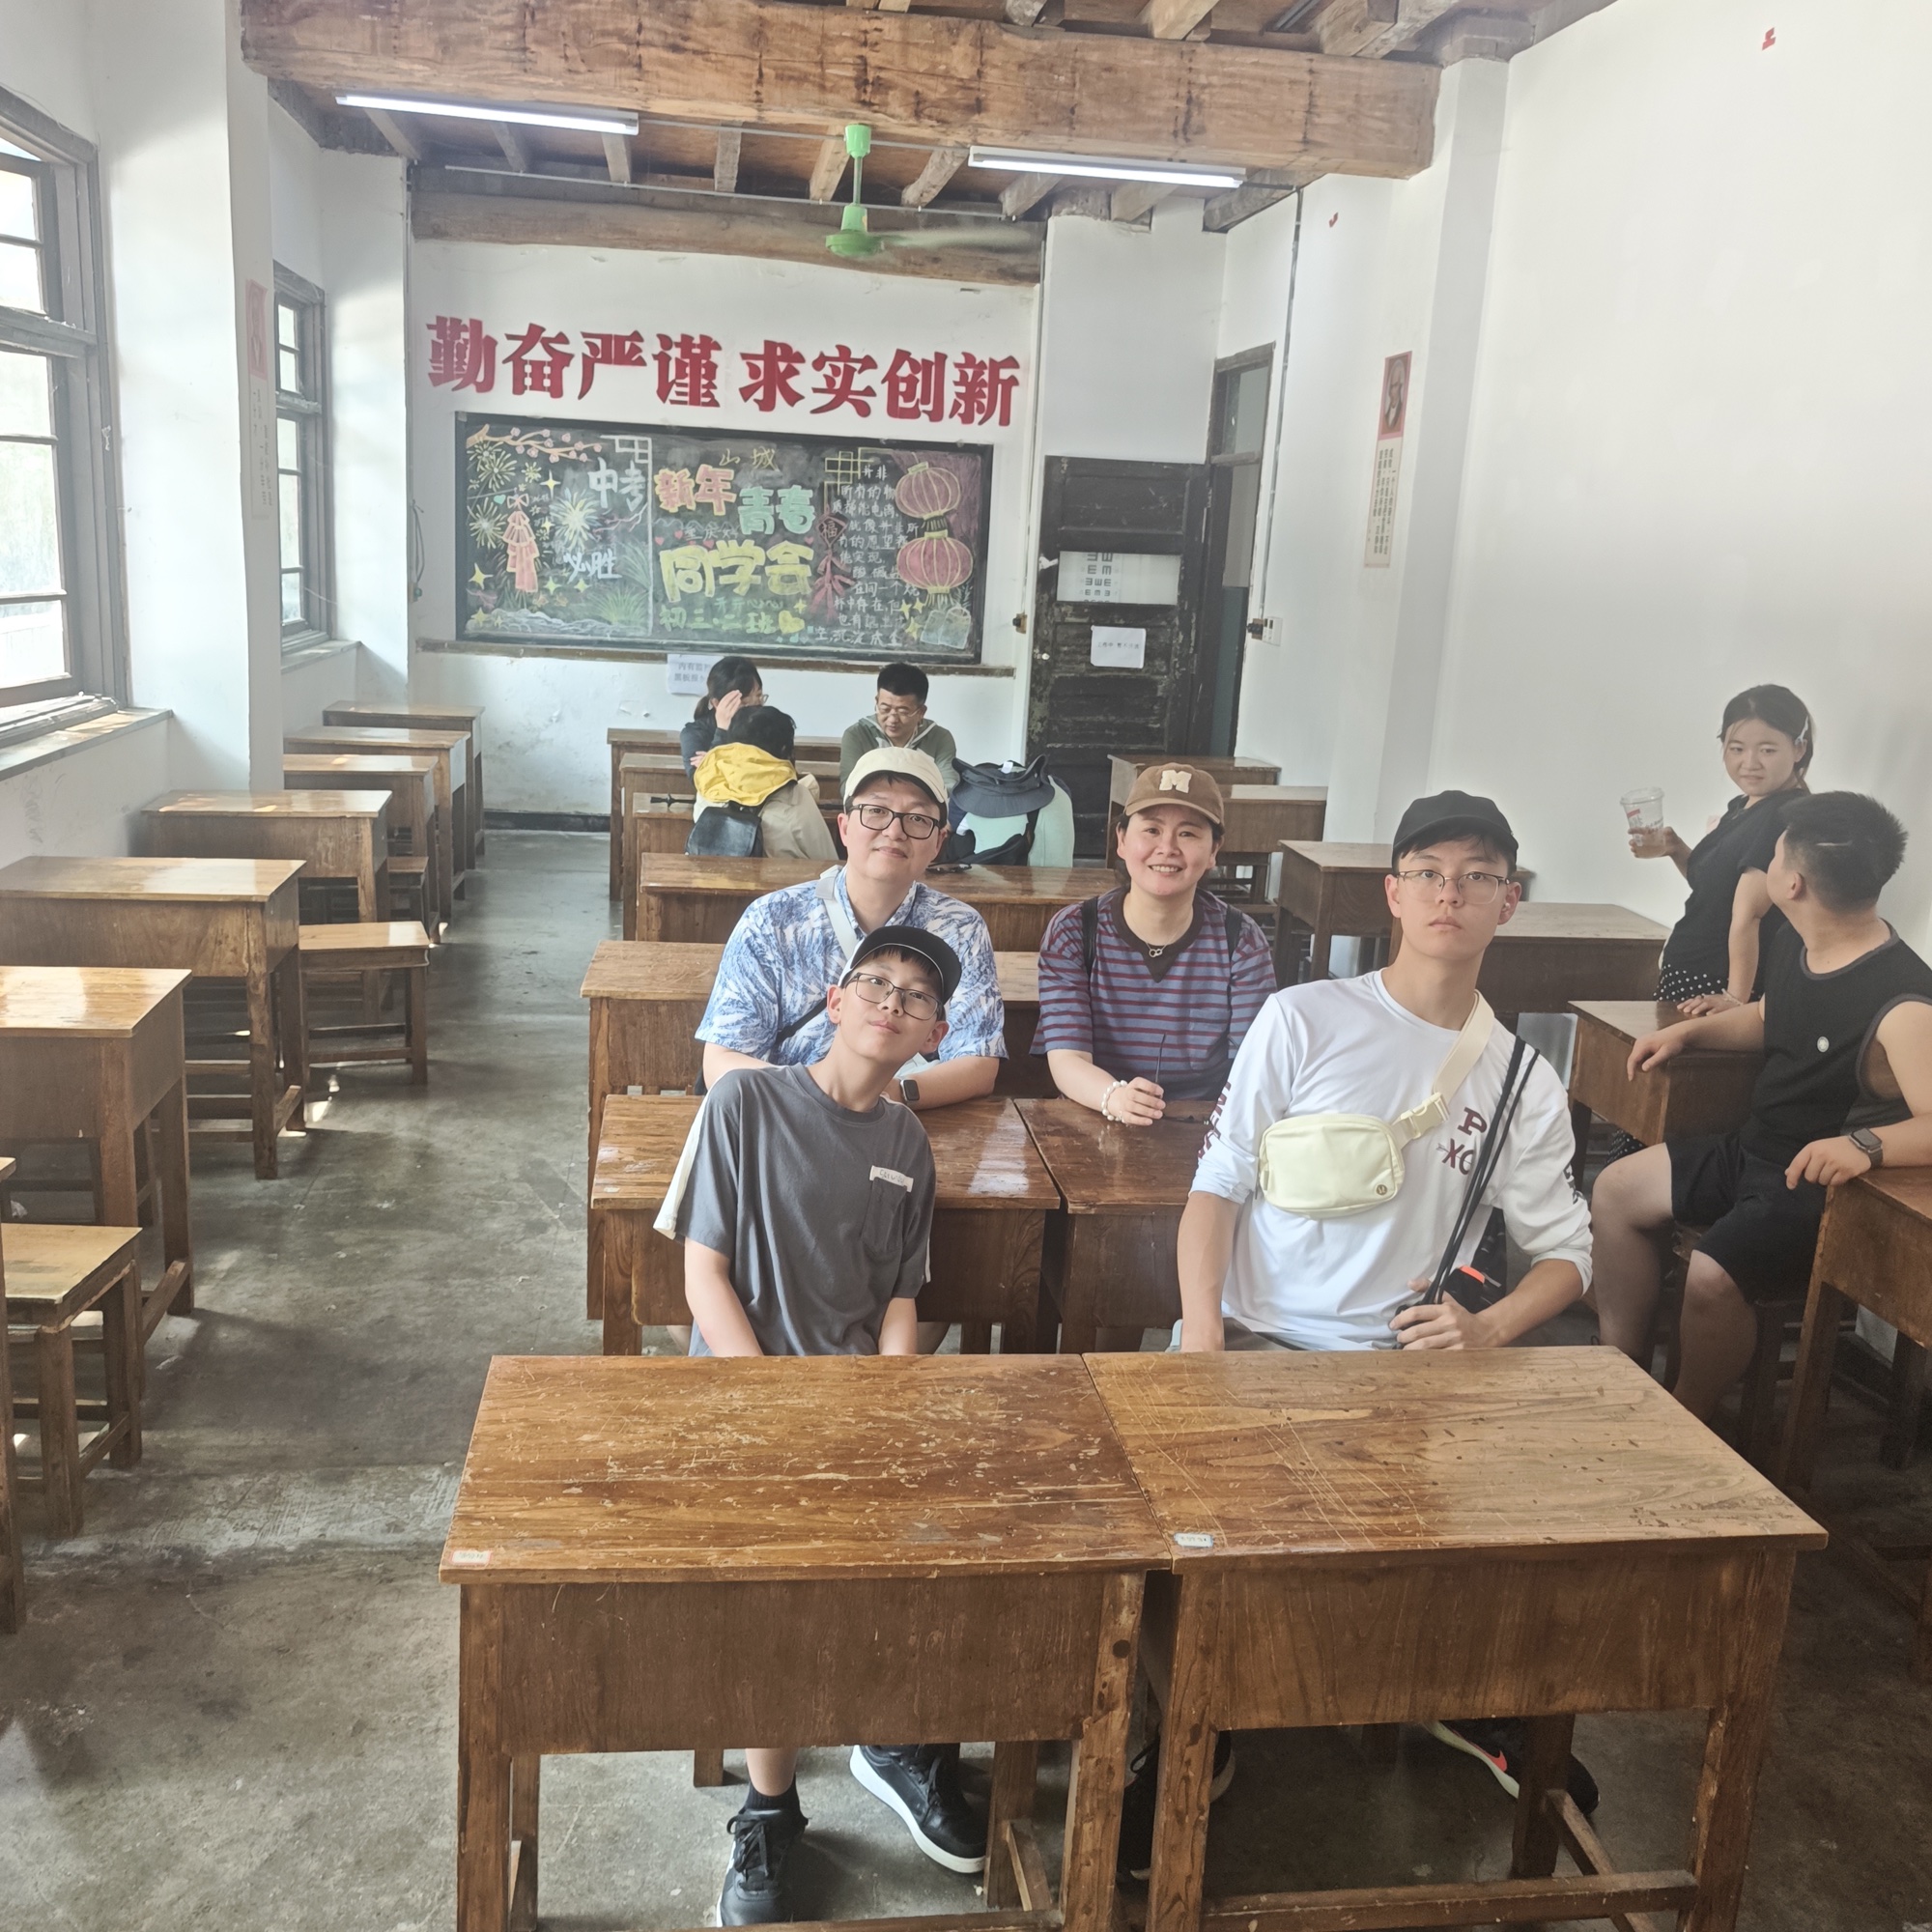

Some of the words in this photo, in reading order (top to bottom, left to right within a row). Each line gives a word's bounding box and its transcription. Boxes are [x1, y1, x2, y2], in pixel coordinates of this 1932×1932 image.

[426, 315, 723, 408] 勤奋严谨
[739, 338, 1021, 427] 求实创新
[719, 446, 779, 471] 山城
[587, 457, 645, 511] 中考
[654, 464, 737, 516] 新年
[738, 485, 816, 534] 青春
[820, 520, 838, 542] 福
[563, 549, 623, 583] 必胜
[659, 539, 814, 603] 同学会
[1159, 770, 1192, 793] M
[1457, 1107, 1488, 1136] P
